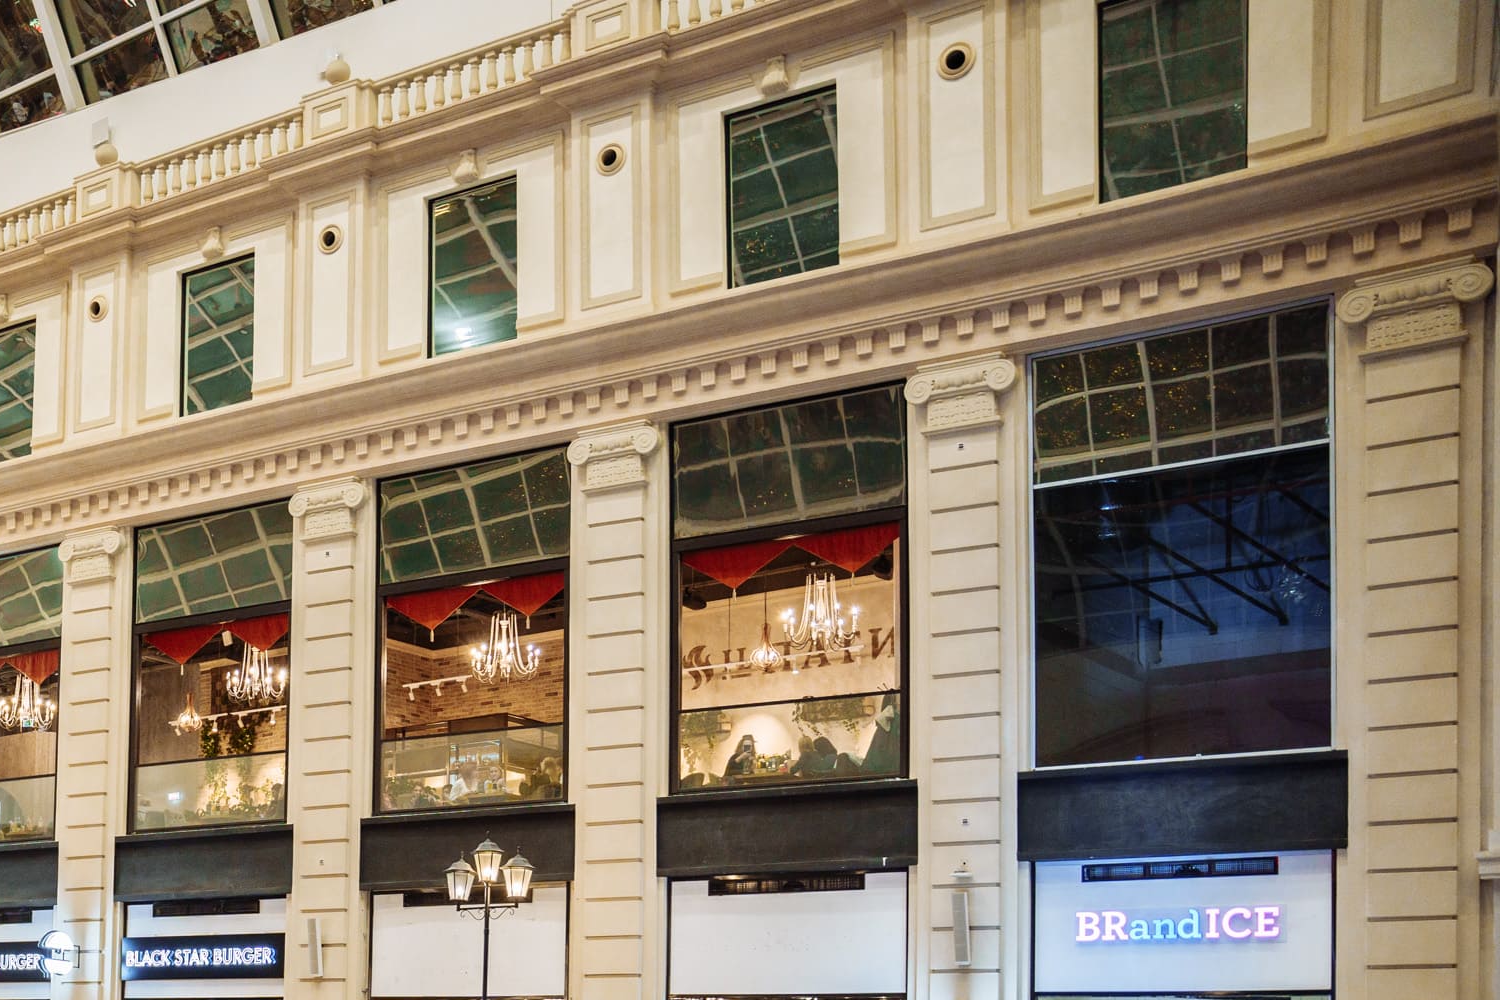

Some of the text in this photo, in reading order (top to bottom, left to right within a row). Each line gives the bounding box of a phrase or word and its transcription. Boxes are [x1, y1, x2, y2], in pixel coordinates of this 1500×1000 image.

[1075, 906, 1280, 942] BRandICE
[125, 946, 274, 967] BLACK STAR BURGER
